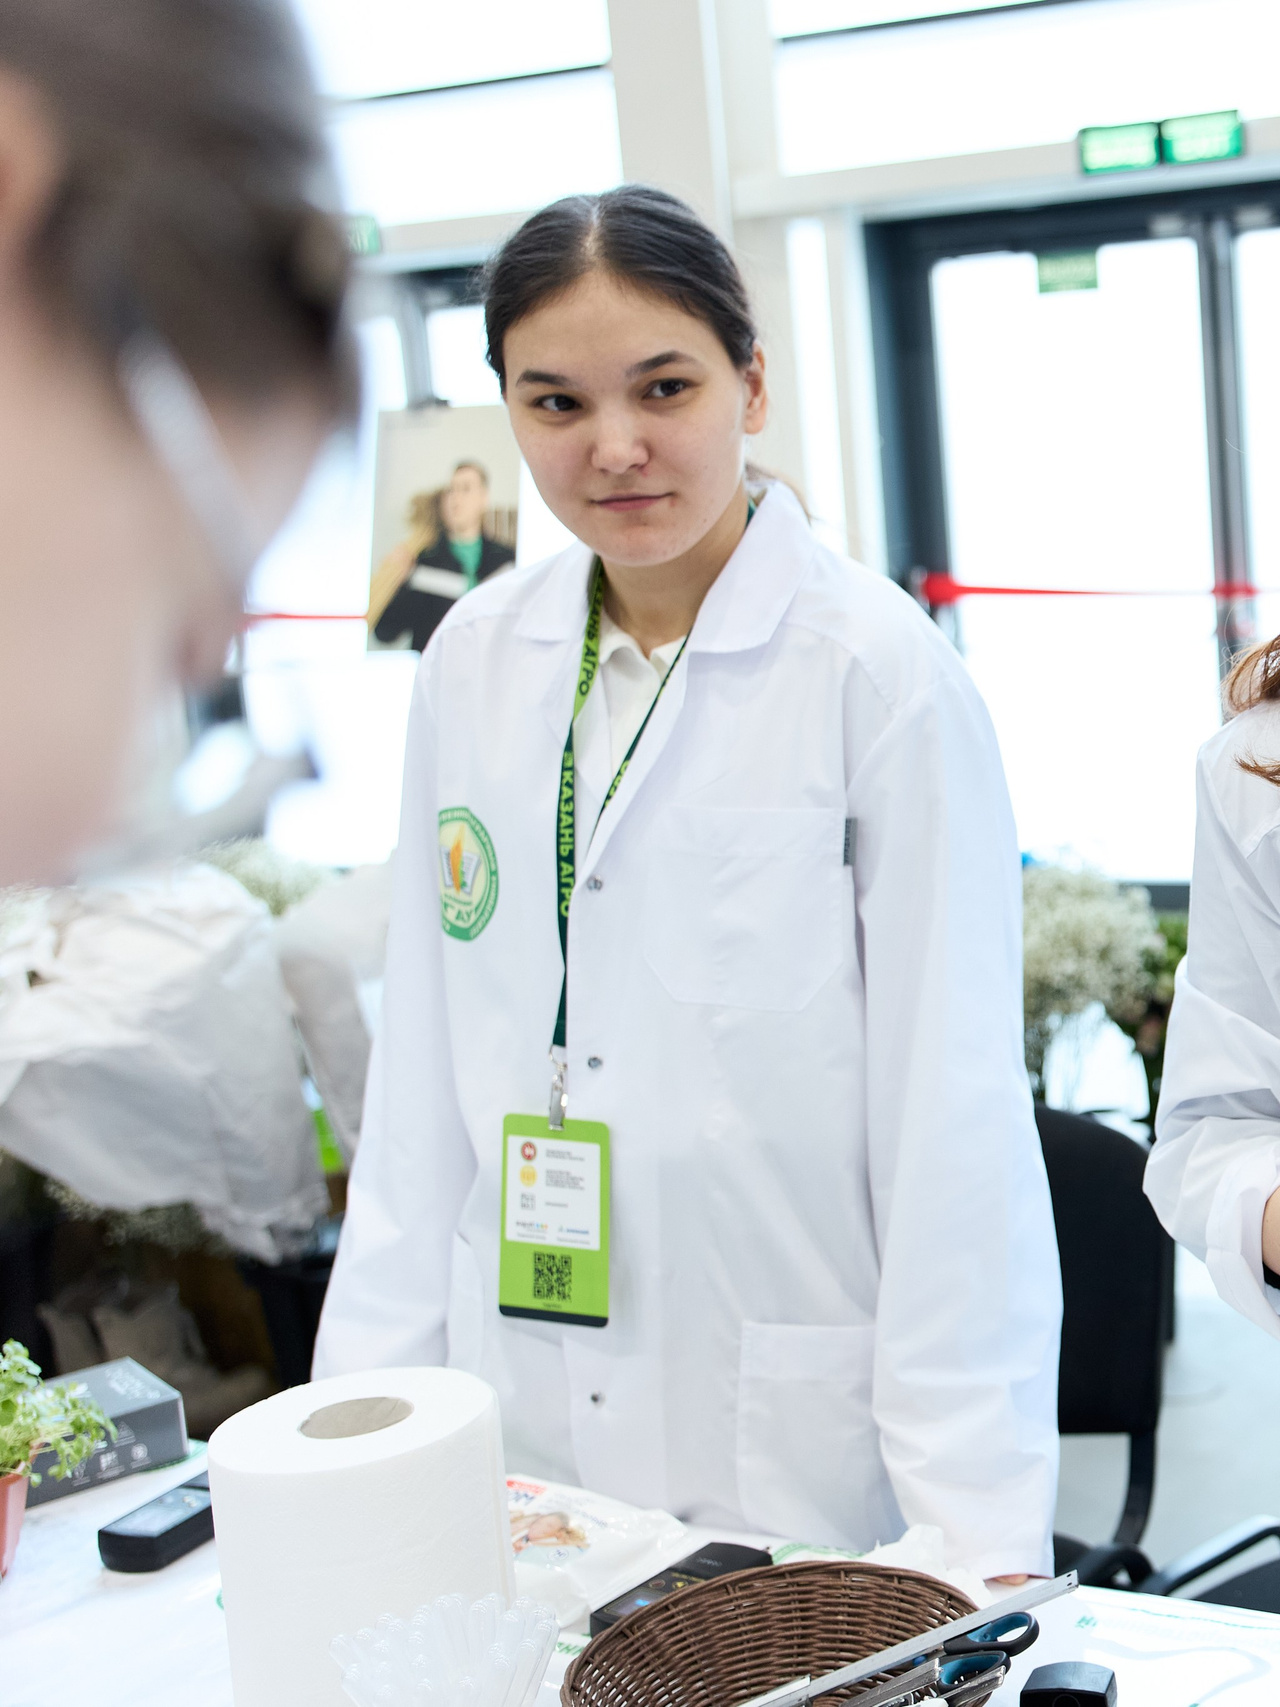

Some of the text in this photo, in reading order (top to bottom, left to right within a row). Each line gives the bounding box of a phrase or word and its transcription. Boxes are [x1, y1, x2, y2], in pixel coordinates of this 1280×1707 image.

[579, 644, 597, 696] АГРО
[559, 769, 575, 918] КАЗАНЬ АГРО
